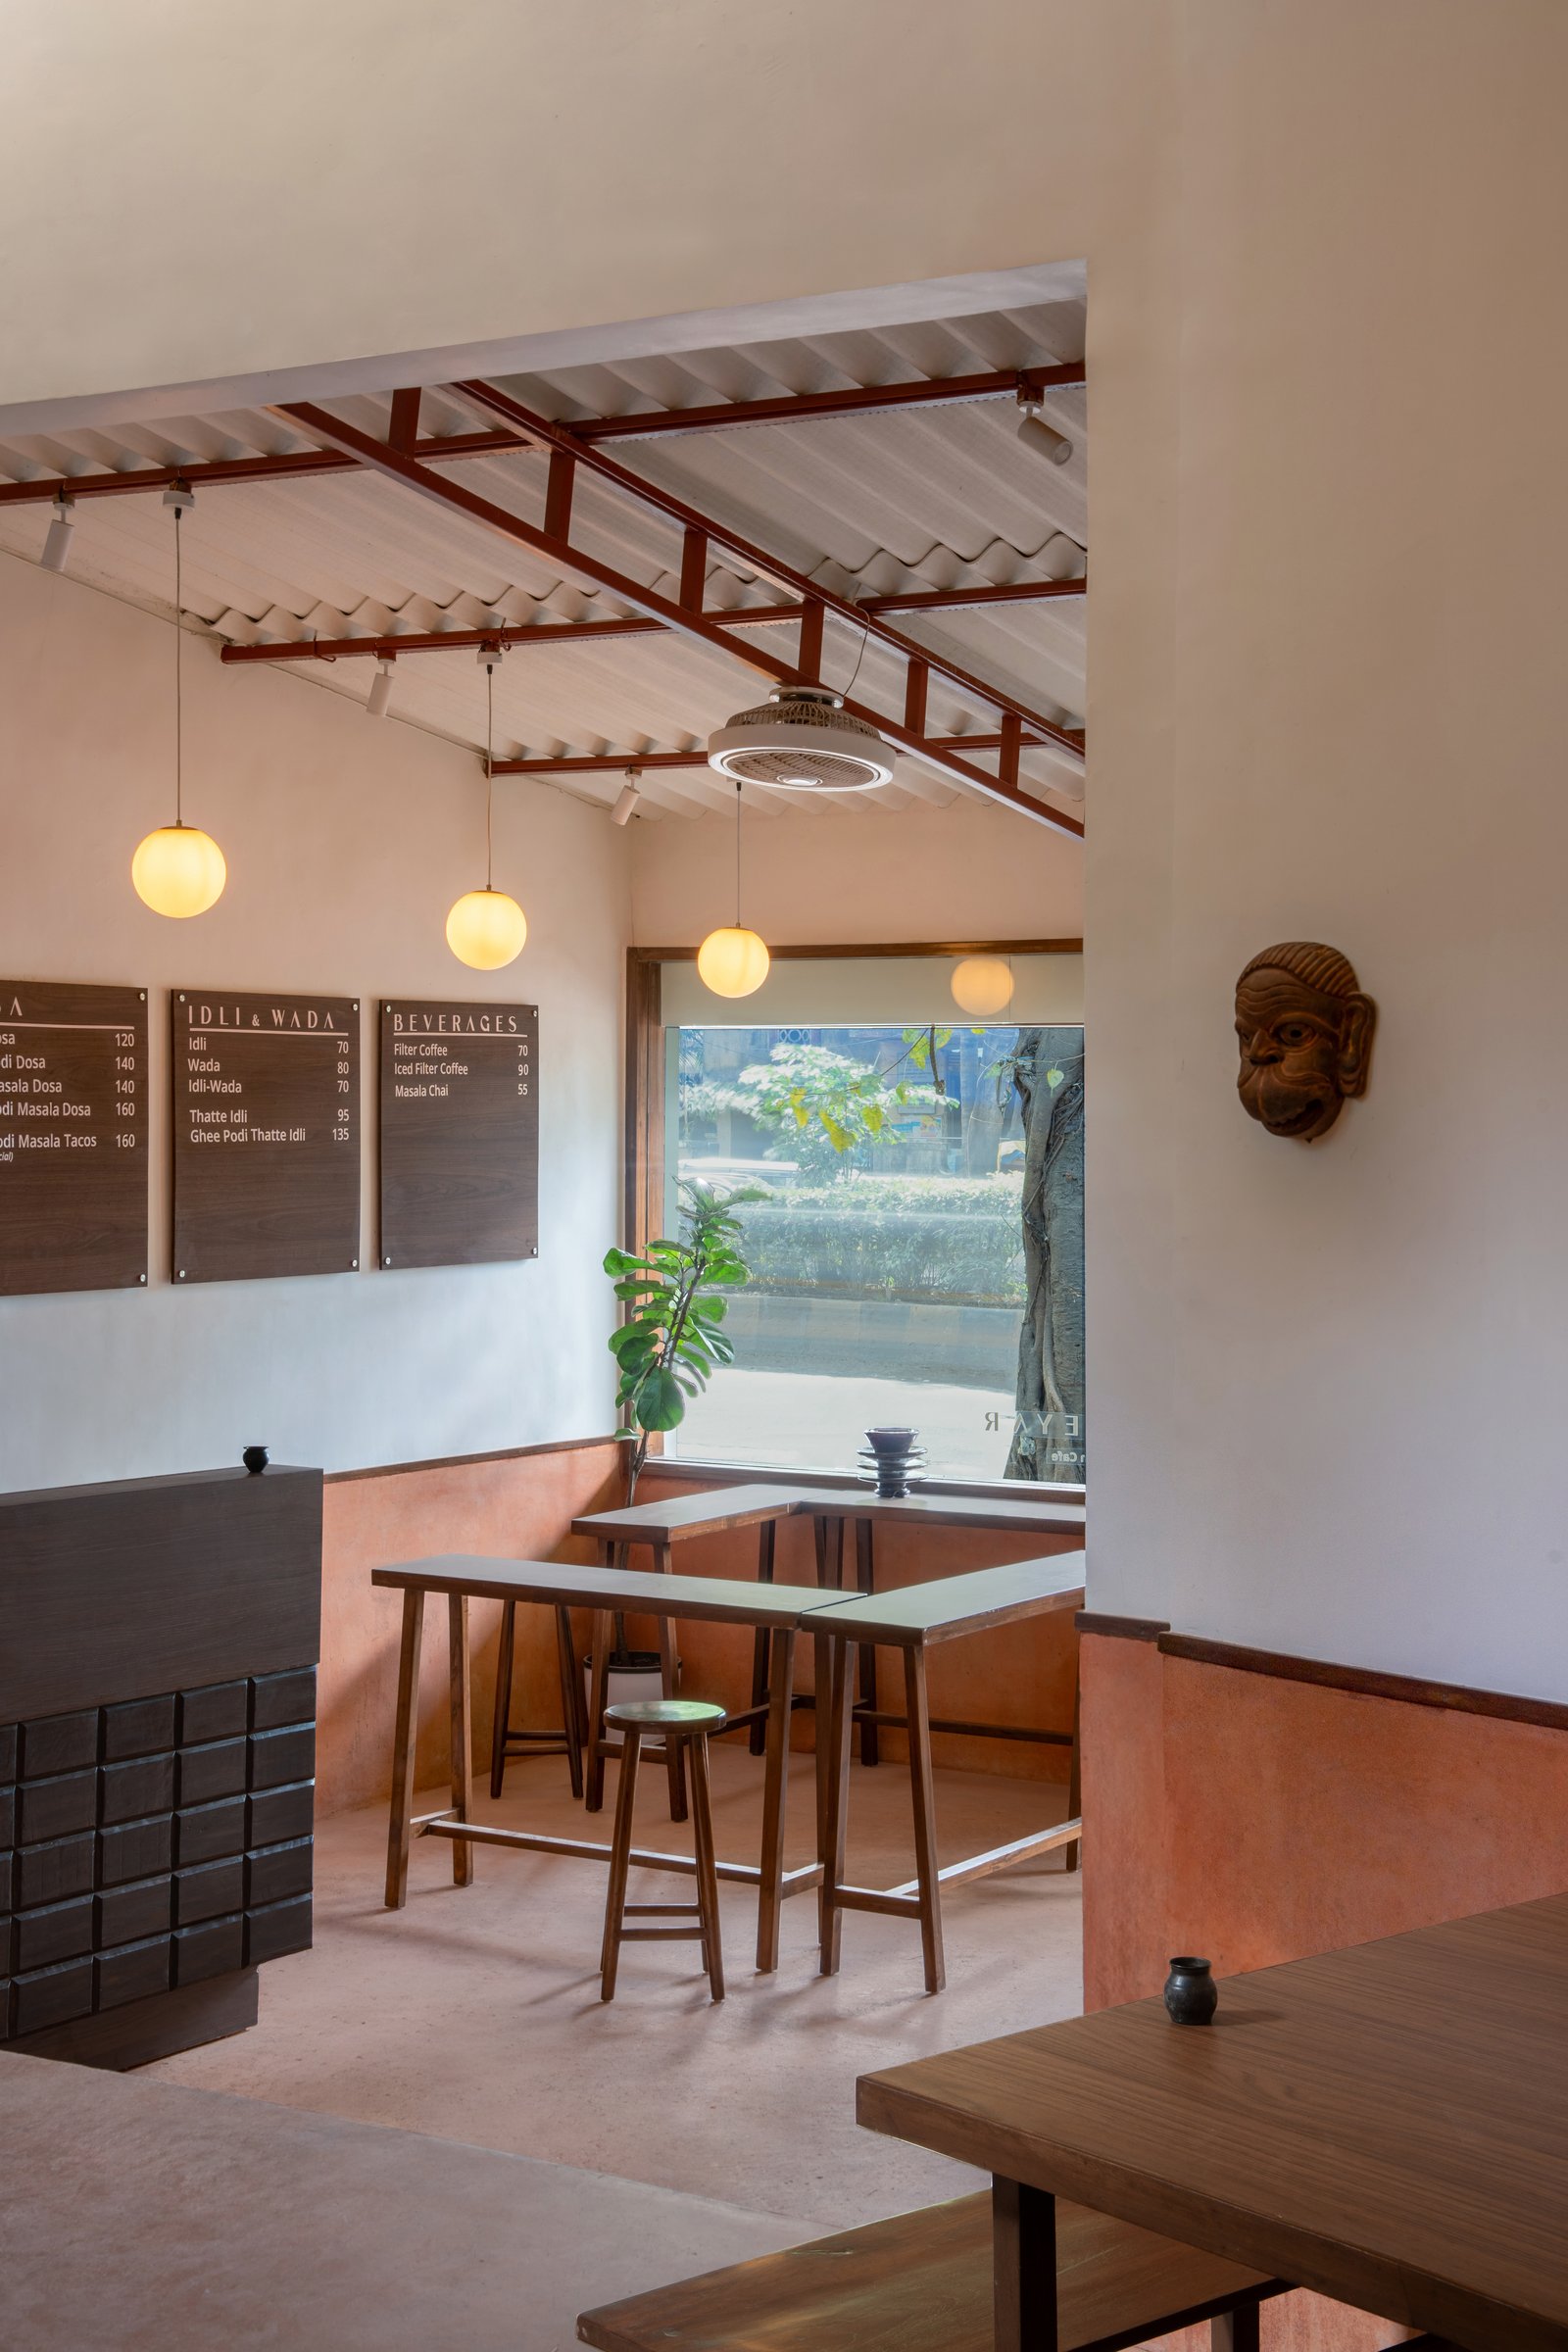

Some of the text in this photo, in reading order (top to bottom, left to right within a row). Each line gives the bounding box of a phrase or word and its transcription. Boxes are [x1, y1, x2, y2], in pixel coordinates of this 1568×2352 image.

[188, 1004, 334, 1029] IDLI & WADA
[394, 1013, 517, 1032] BEVERAGES
[0, 1033, 135, 1048] sa 120
[189, 1036, 349, 1054] Idli 70
[394, 1043, 528, 1056] Filter Coffee 70
[16, 1055, 46, 1069] Dosa
[115, 1055, 135, 1071] 140
[187, 1057, 350, 1075] Wada 80
[394, 1061, 529, 1076] Iced Filter Coffee 90
[32, 1078, 63, 1094] Dosa
[115, 1080, 135, 1094] 140
[188, 1078, 350, 1094] Idli-Wada 70
[395, 1083, 528, 1098] Masala Chai 55
[0, 1101, 135, 1117] di Masala Dosa 160
[188, 1108, 350, 1123] Thatte Idli 95
[18, 1134, 61, 1149] Masala
[63, 1133, 97, 1148] Tacos
[116, 1134, 135, 1149] 160
[190, 1127, 350, 1144] Ghee Podi Thatte Idli 135
